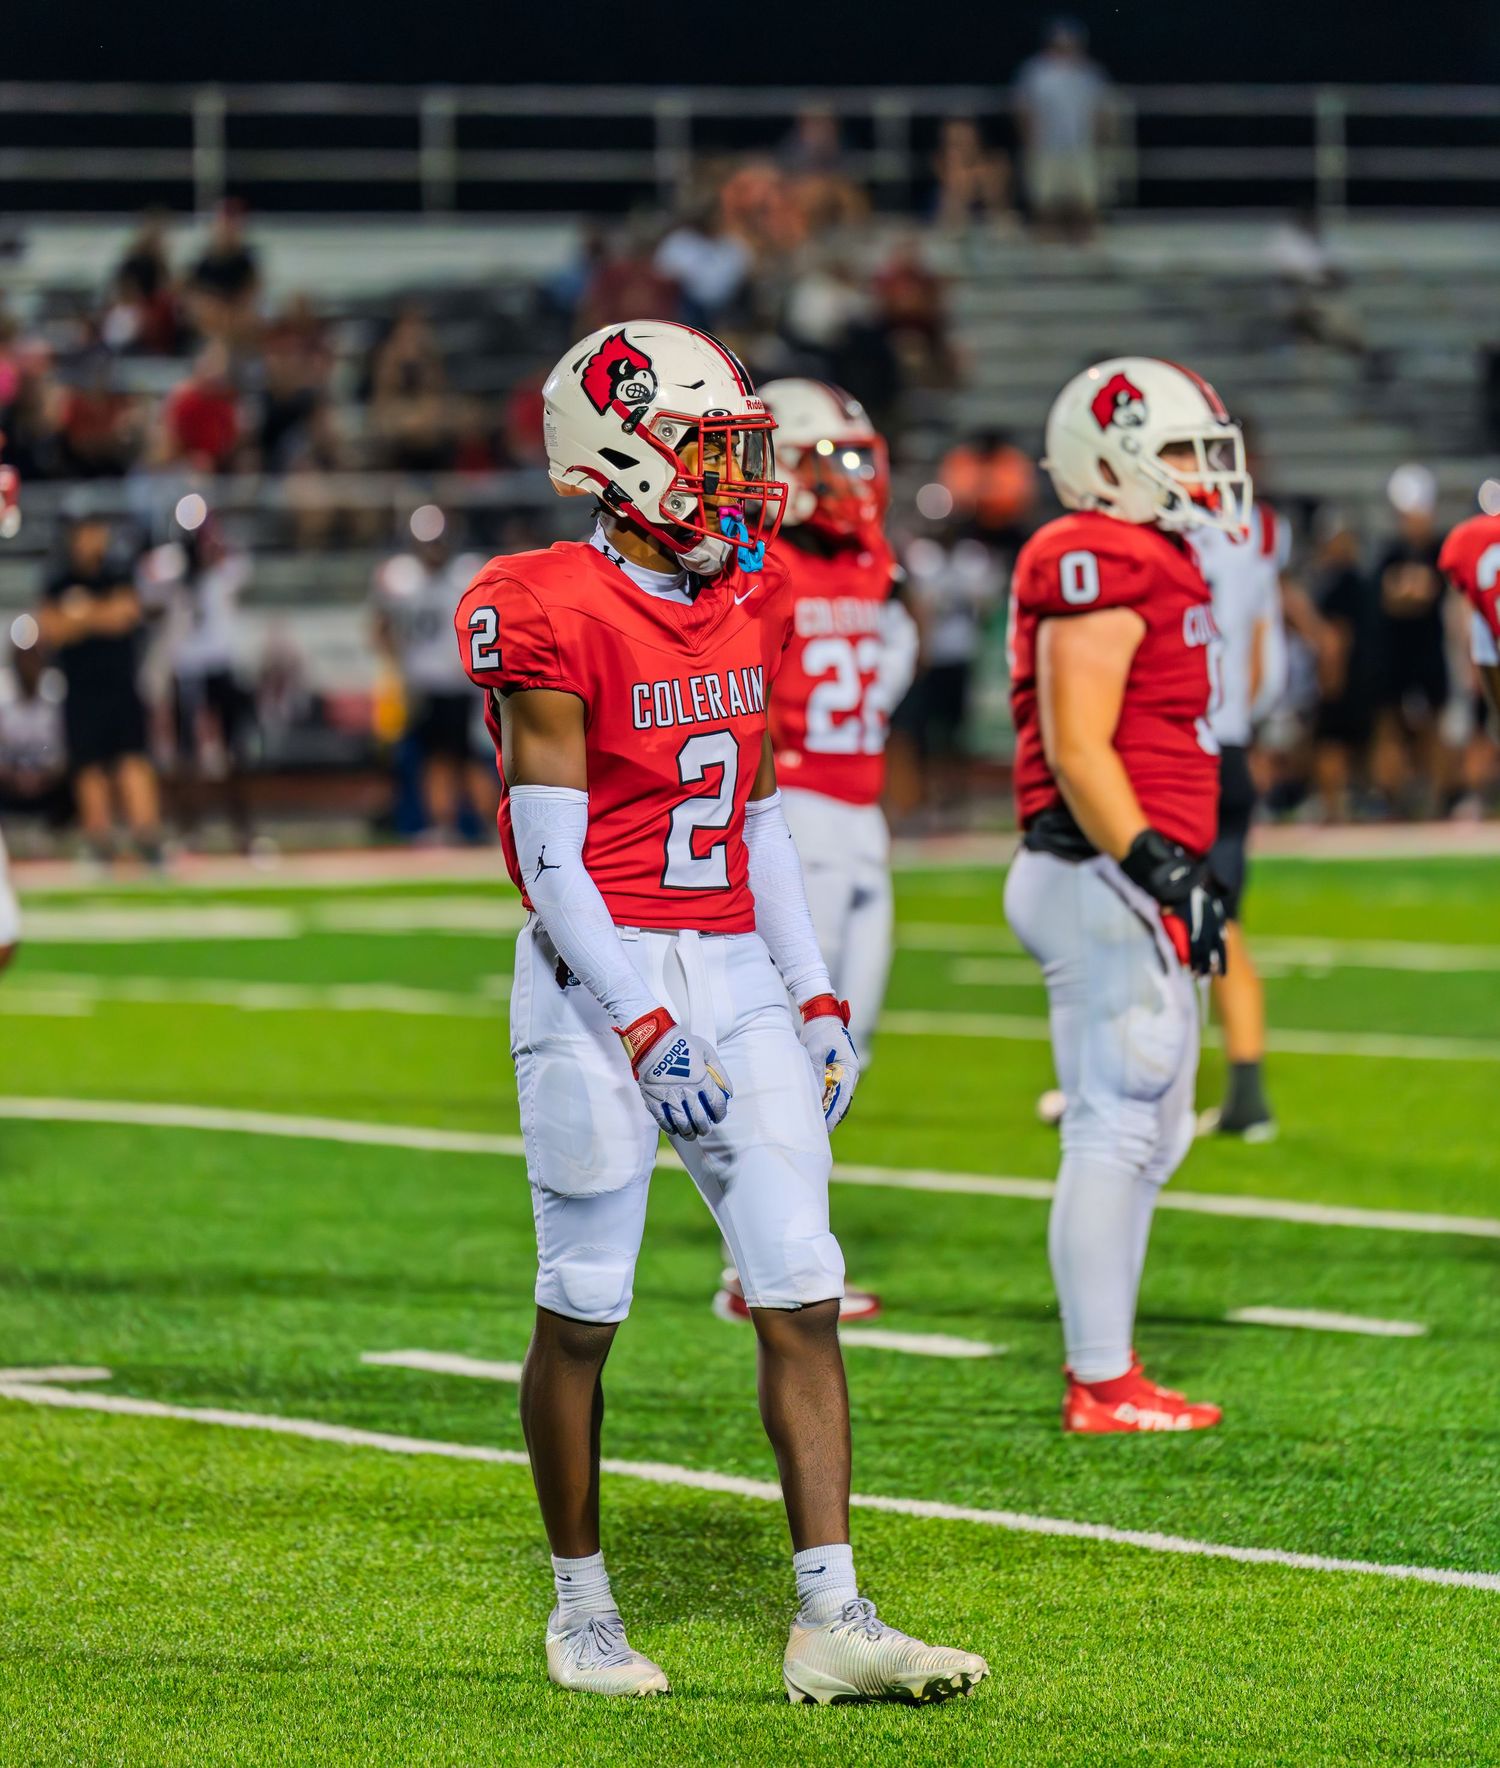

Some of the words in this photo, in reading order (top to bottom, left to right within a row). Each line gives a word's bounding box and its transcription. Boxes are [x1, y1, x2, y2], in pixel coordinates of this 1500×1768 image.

[1059, 550, 1100, 604] 0
[468, 606, 503, 674] 2
[631, 665, 765, 730] COLERAIN
[660, 728, 739, 890] 2
[652, 1038, 687, 1078] adidas
